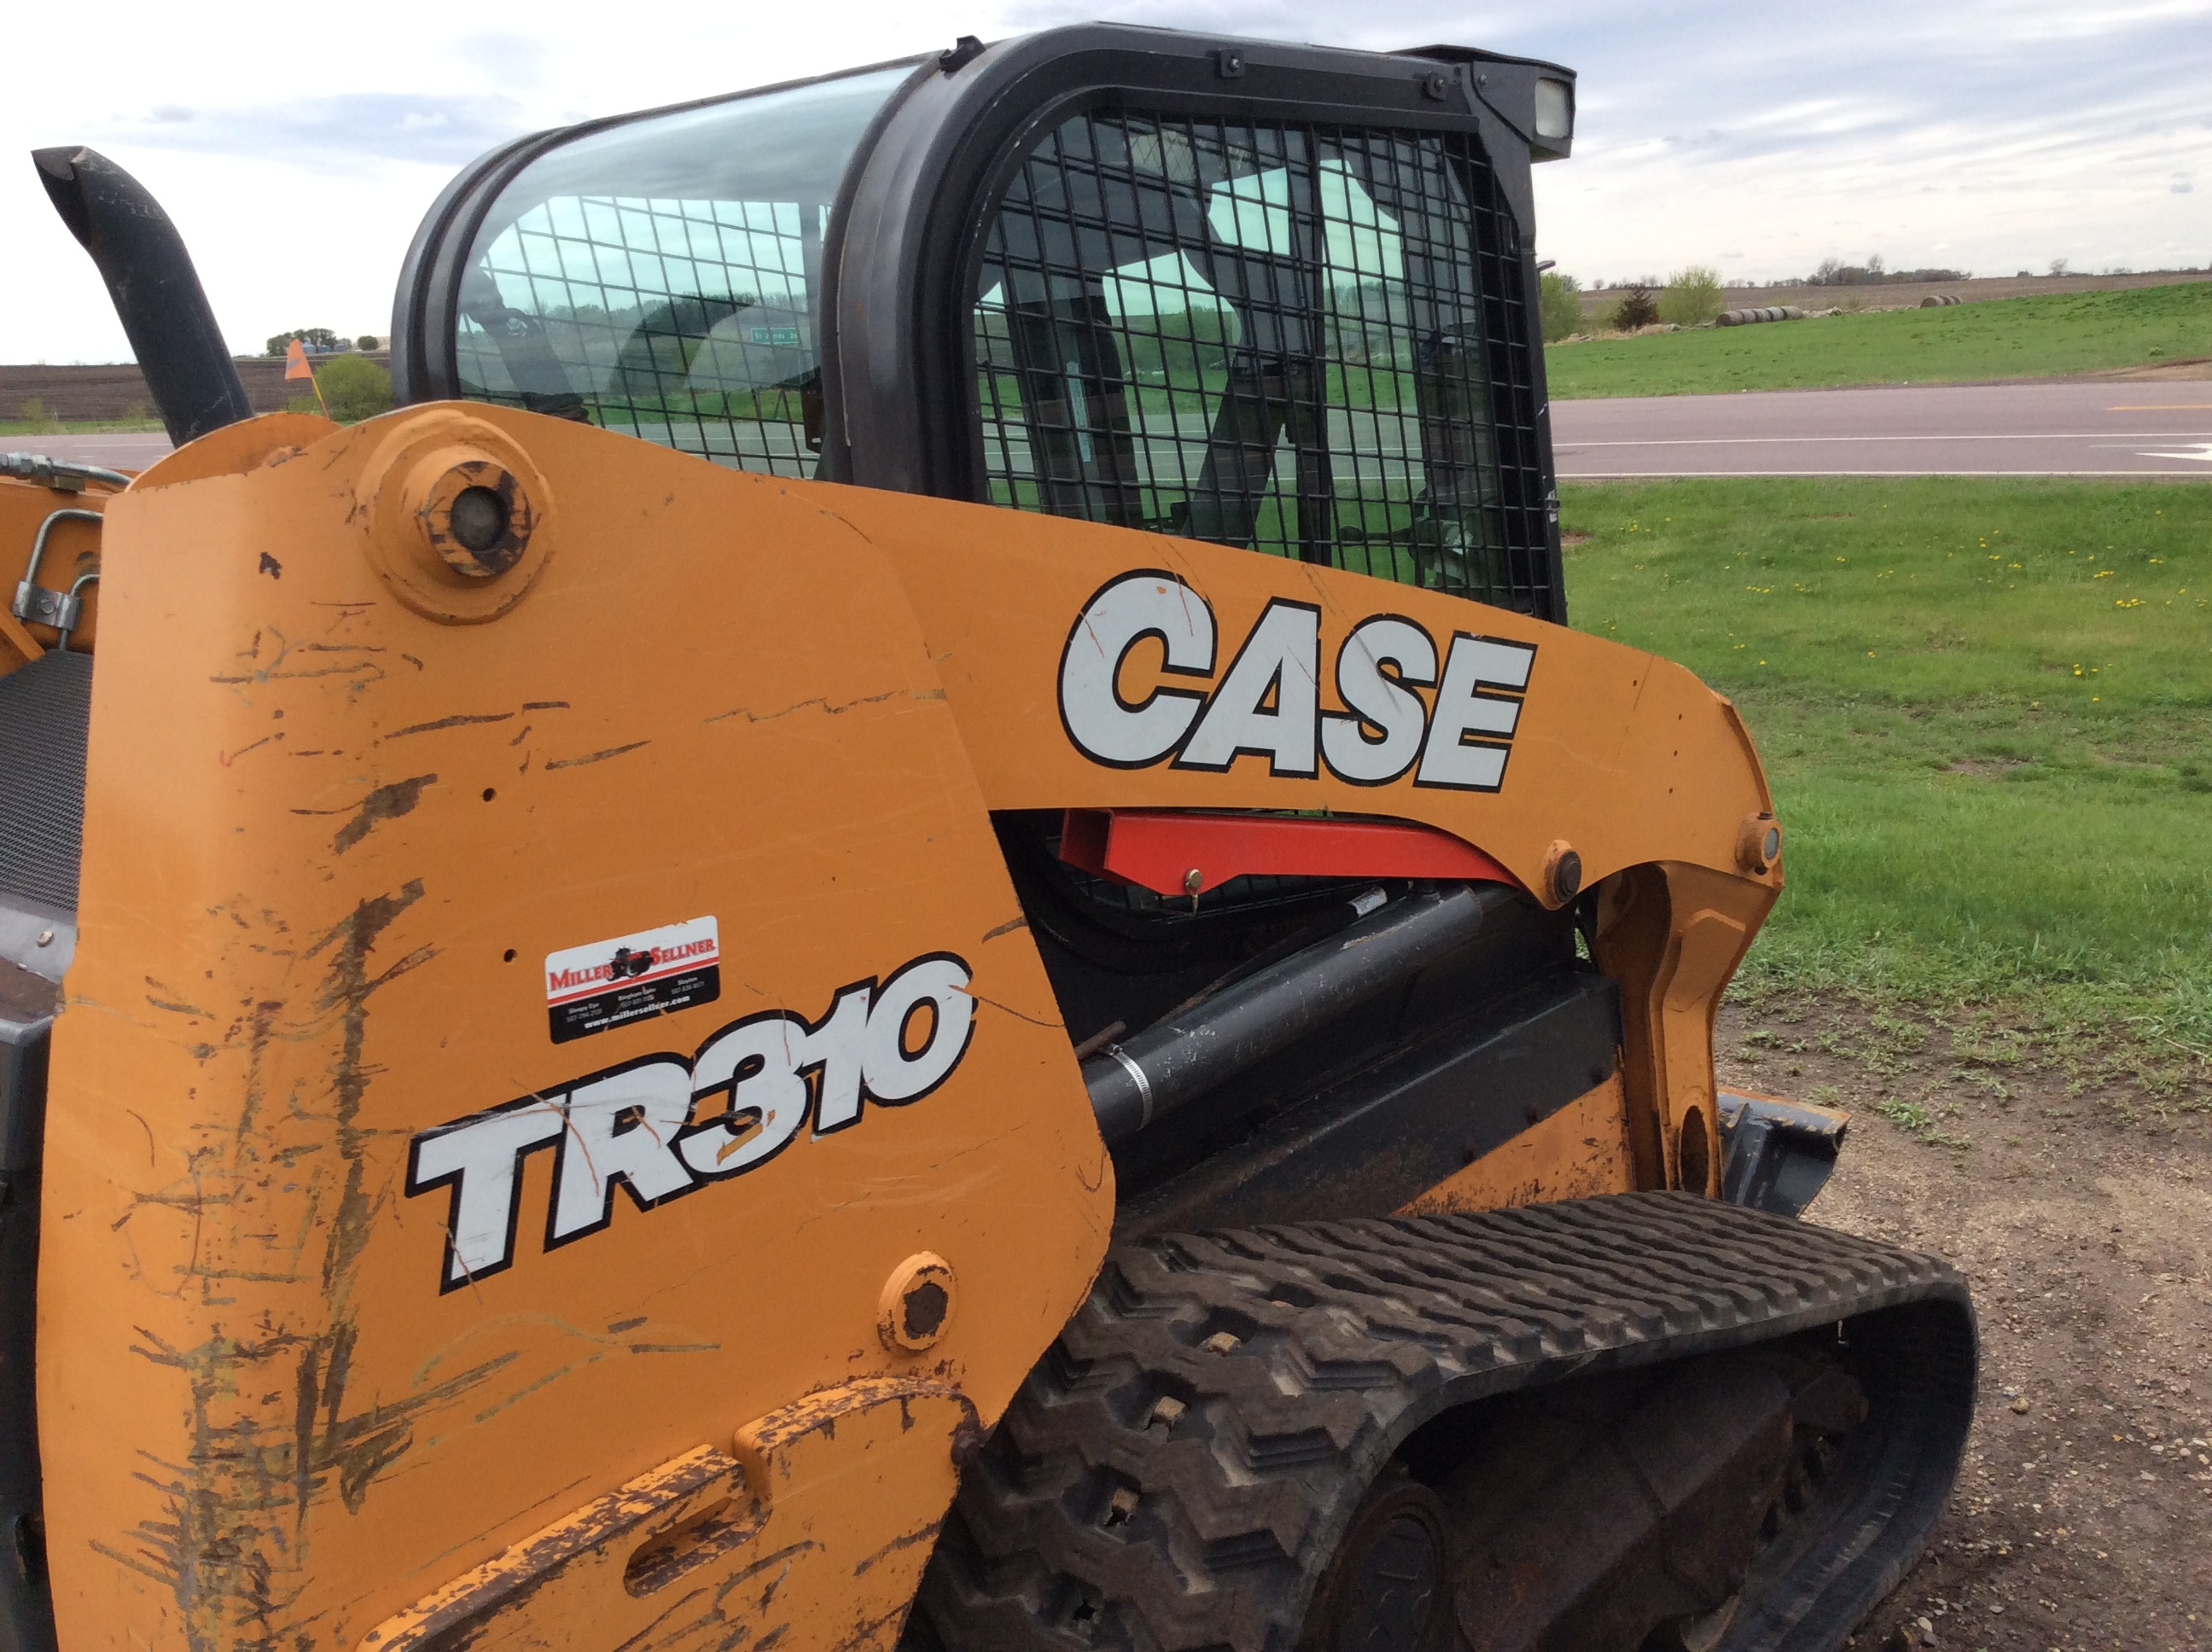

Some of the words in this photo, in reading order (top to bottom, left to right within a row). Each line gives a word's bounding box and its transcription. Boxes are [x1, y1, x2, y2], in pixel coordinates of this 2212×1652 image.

[1057, 568, 1538, 793] CASE
[549, 963, 613, 992] MILLER
[649, 939, 716, 965] SELLNER
[405, 951, 979, 1296] TR310
